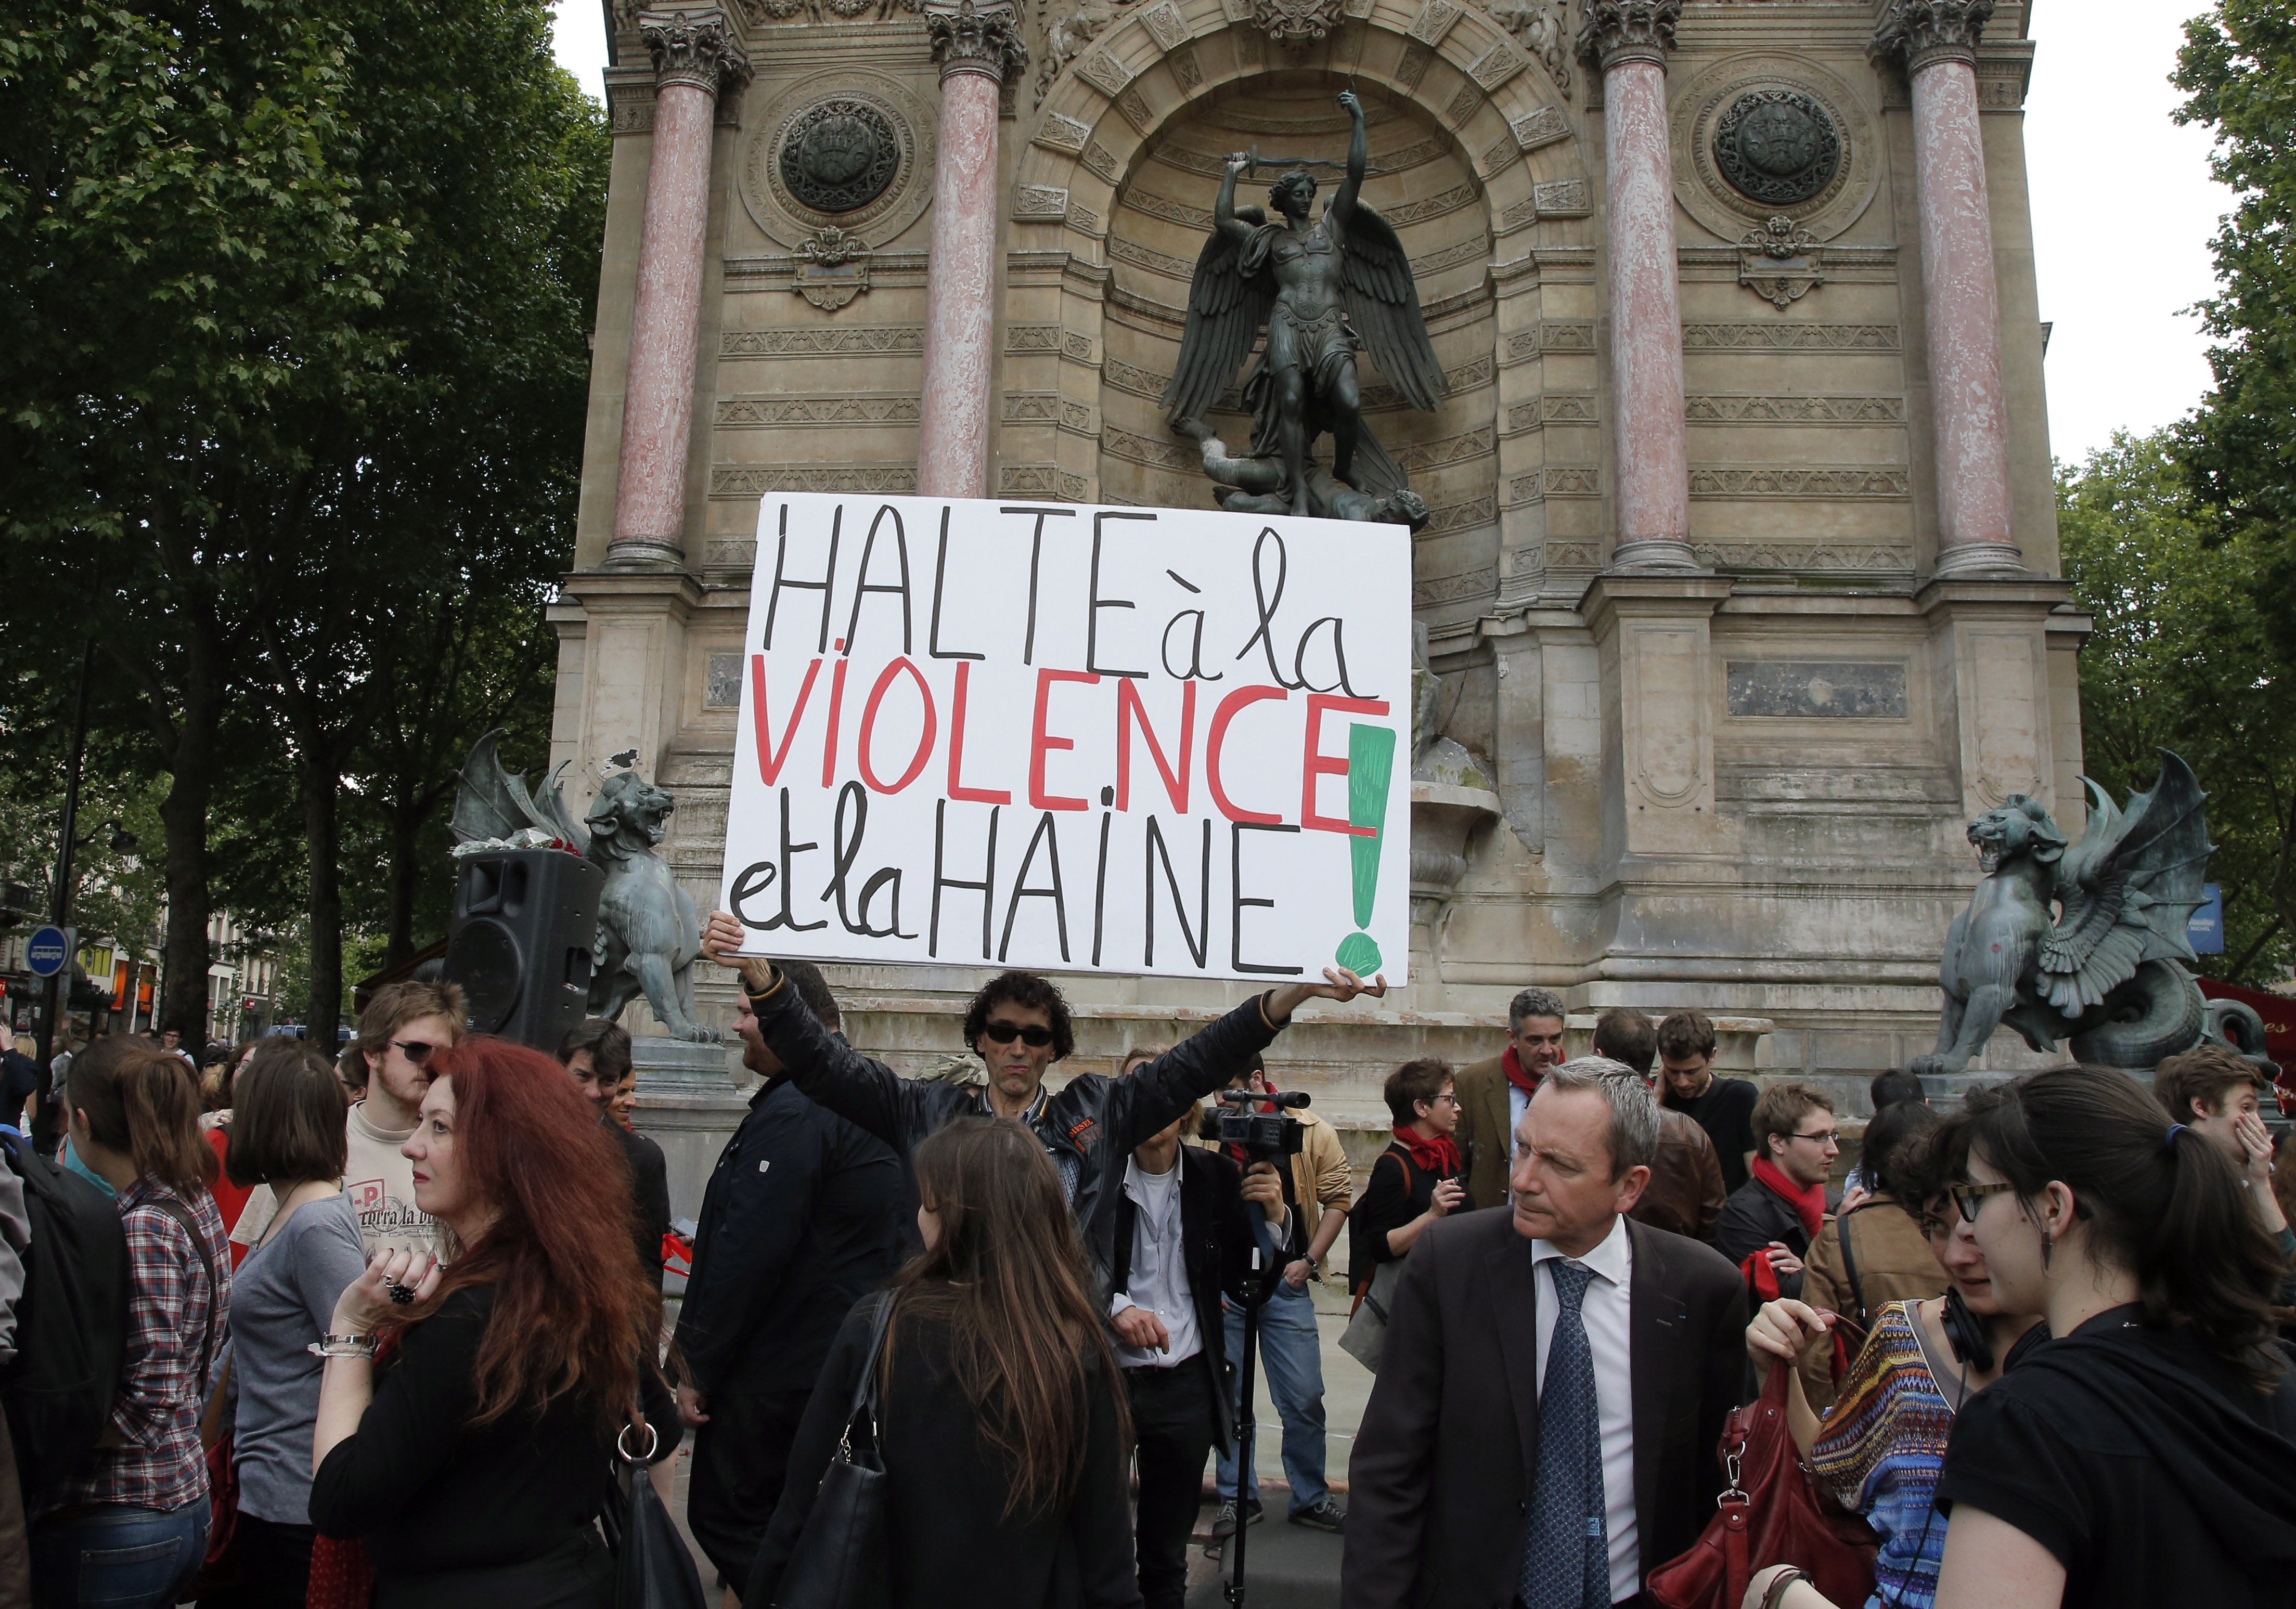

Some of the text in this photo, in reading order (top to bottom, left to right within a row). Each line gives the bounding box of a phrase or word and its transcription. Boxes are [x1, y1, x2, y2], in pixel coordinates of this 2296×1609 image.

[764, 504, 1385, 700] HALTE à la
[729, 787, 828, 931] et
[820, 780, 919, 939] la
[1069, 1119, 1094, 1138] DIESEL
[402, 1205, 415, 1225] la
